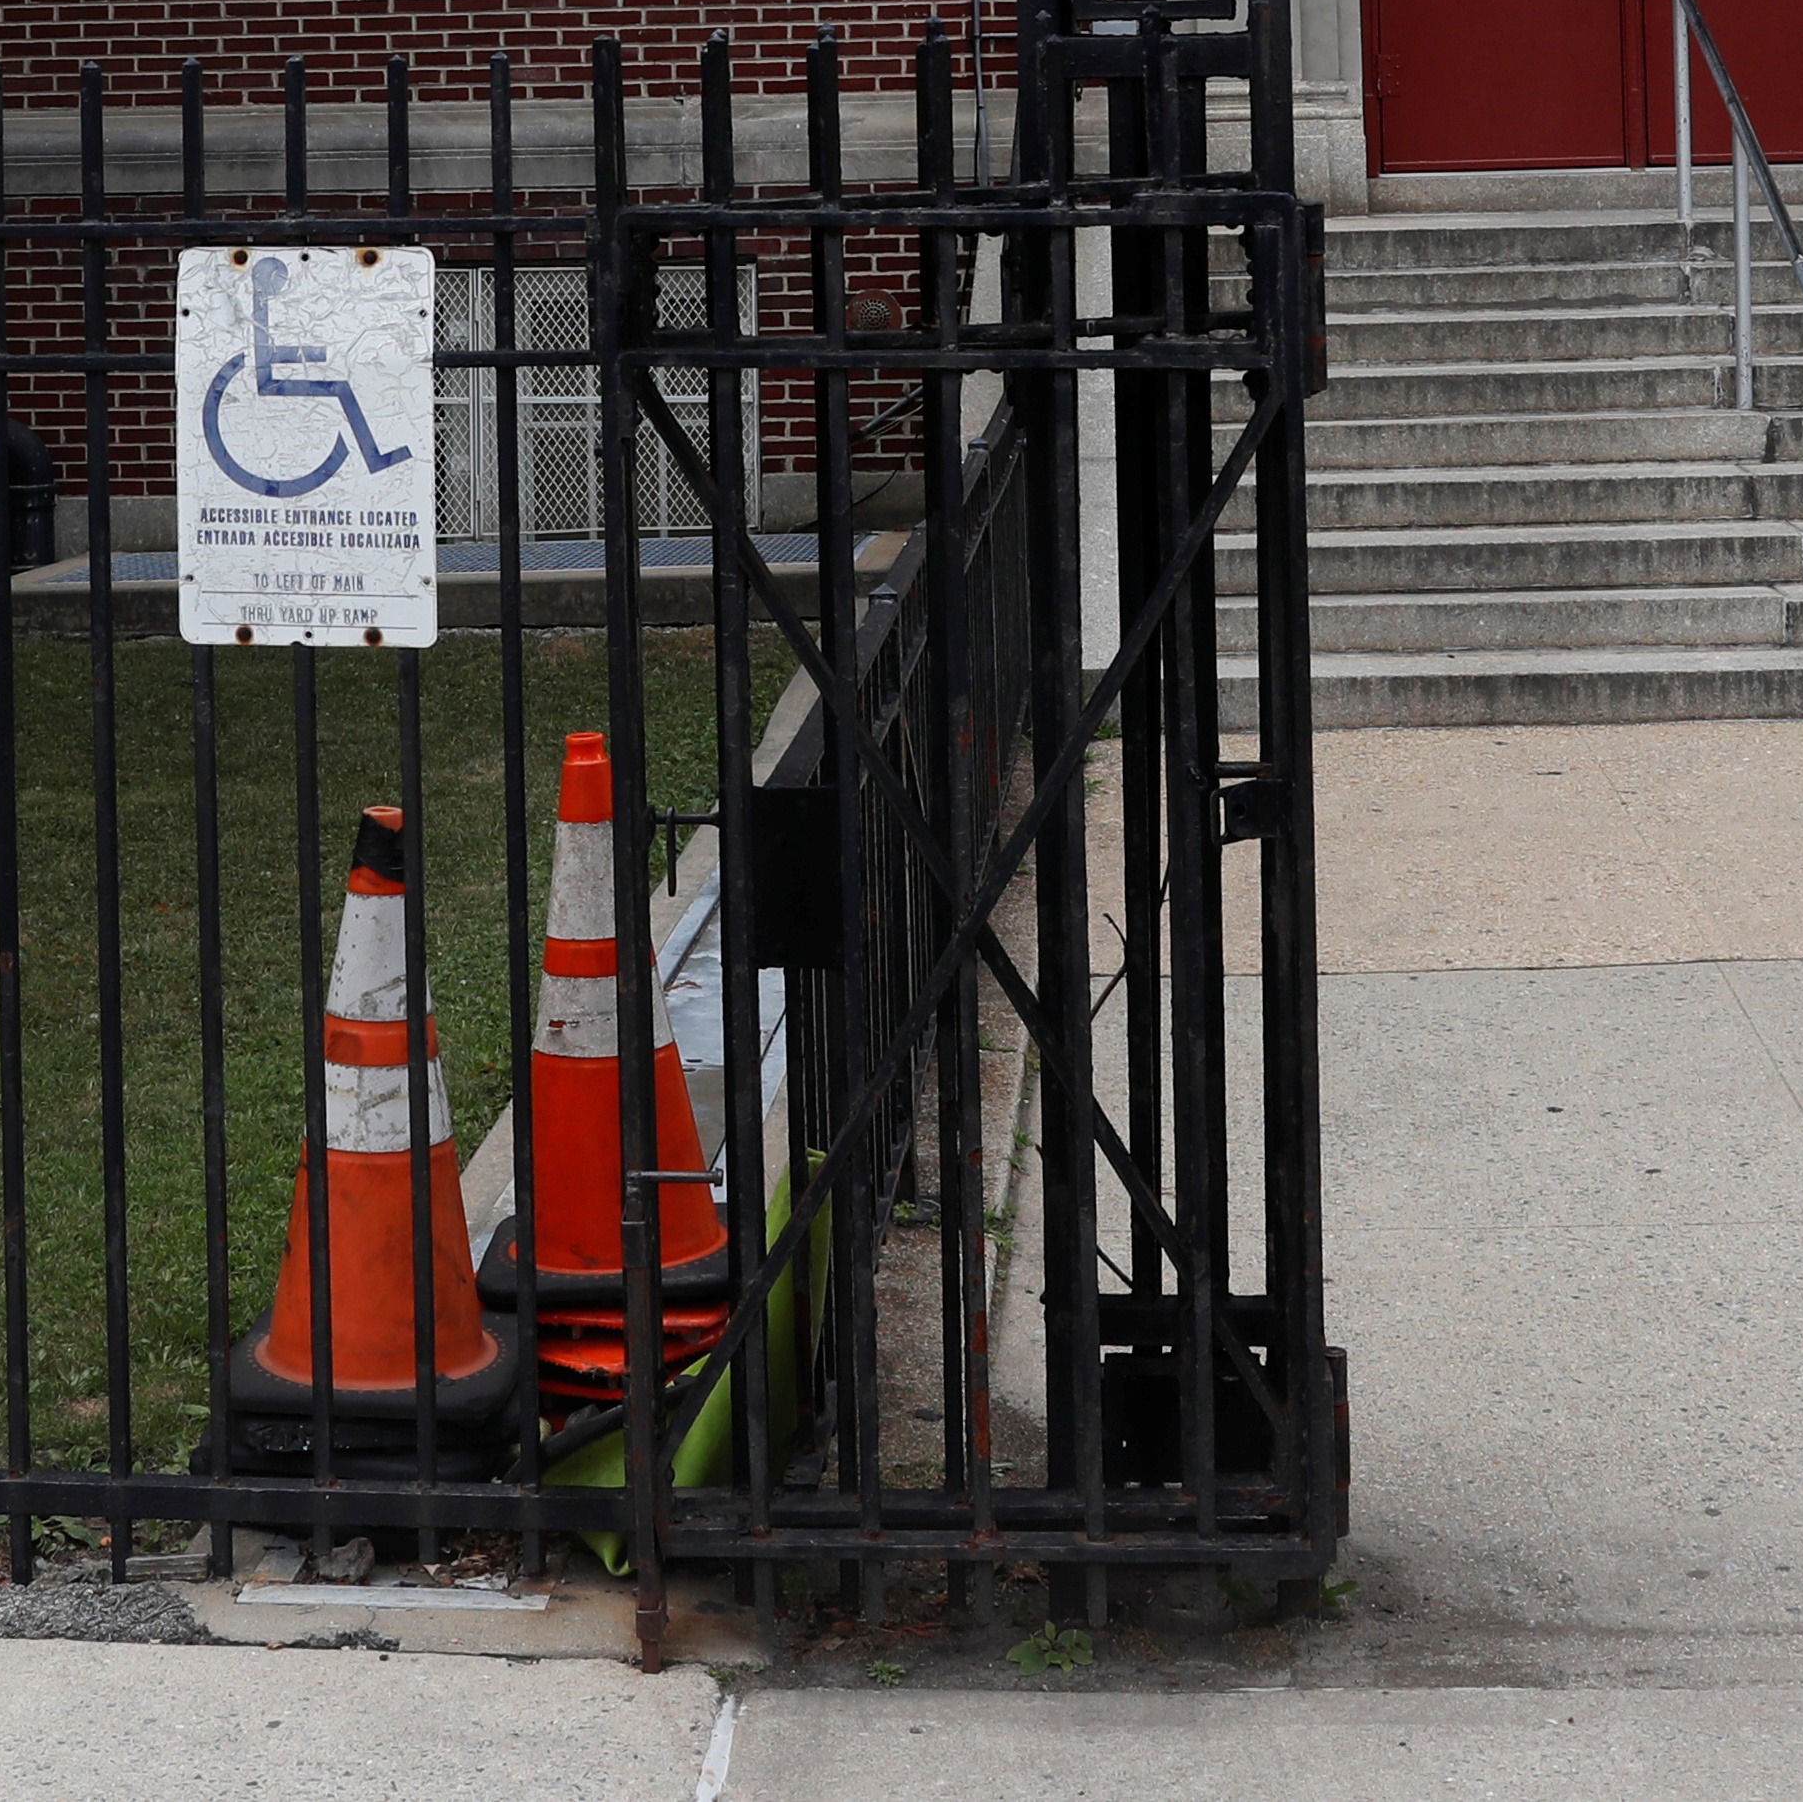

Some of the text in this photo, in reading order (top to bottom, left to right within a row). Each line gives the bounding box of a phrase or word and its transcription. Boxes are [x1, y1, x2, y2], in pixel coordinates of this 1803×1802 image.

[199, 507, 418, 527] ACCESSIBLE ENTRANCE LOCATED
[197, 529, 421, 549] ENTRADA ACCESIBLE LOCALIZADA
[253, 573, 364, 591] TO LEFT OF MAIN
[241, 606, 379, 624] THRU YARD UP RAMP
